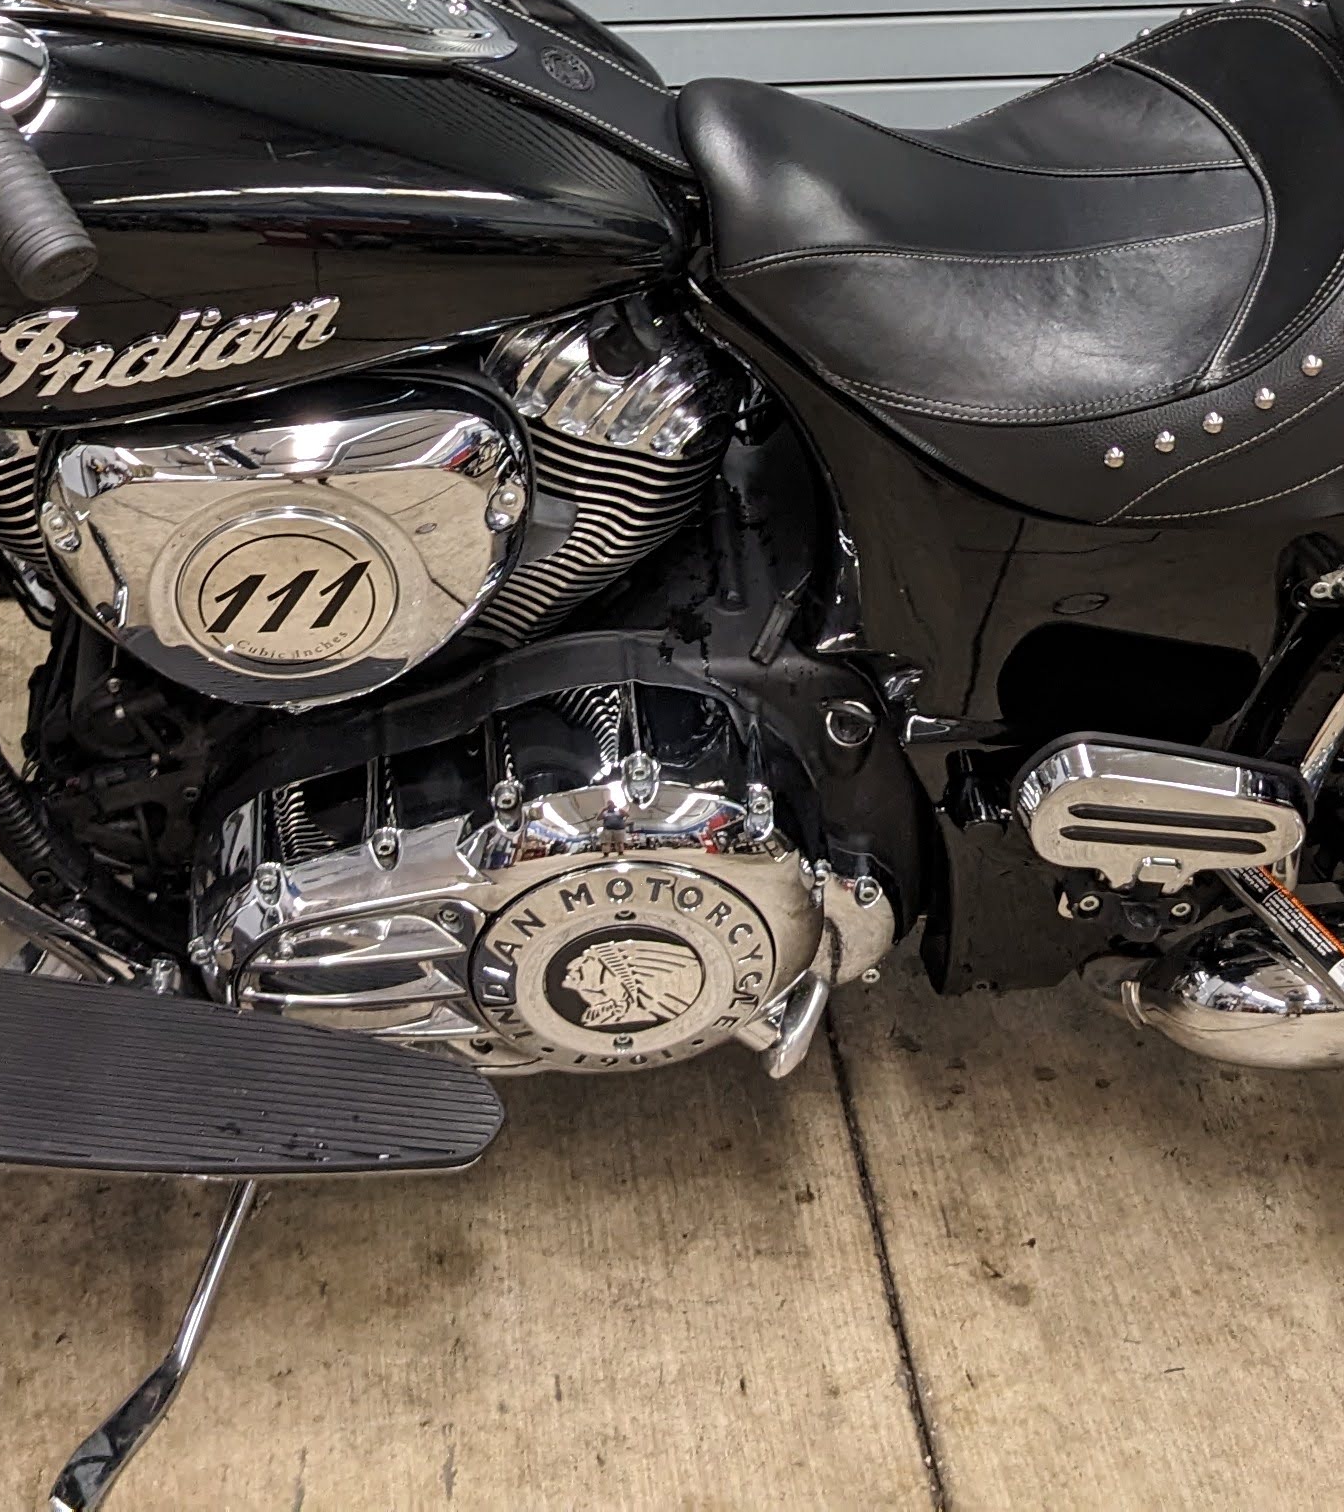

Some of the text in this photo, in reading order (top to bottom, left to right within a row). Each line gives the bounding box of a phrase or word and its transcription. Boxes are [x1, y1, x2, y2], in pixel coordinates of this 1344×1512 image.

[206, 560, 372, 633] 111
[236, 630, 348, 659] Cubic Inches
[483, 876, 764, 1040] INDIAN MOTORCYCLE
[573, 1049, 675, 1066] 1901
